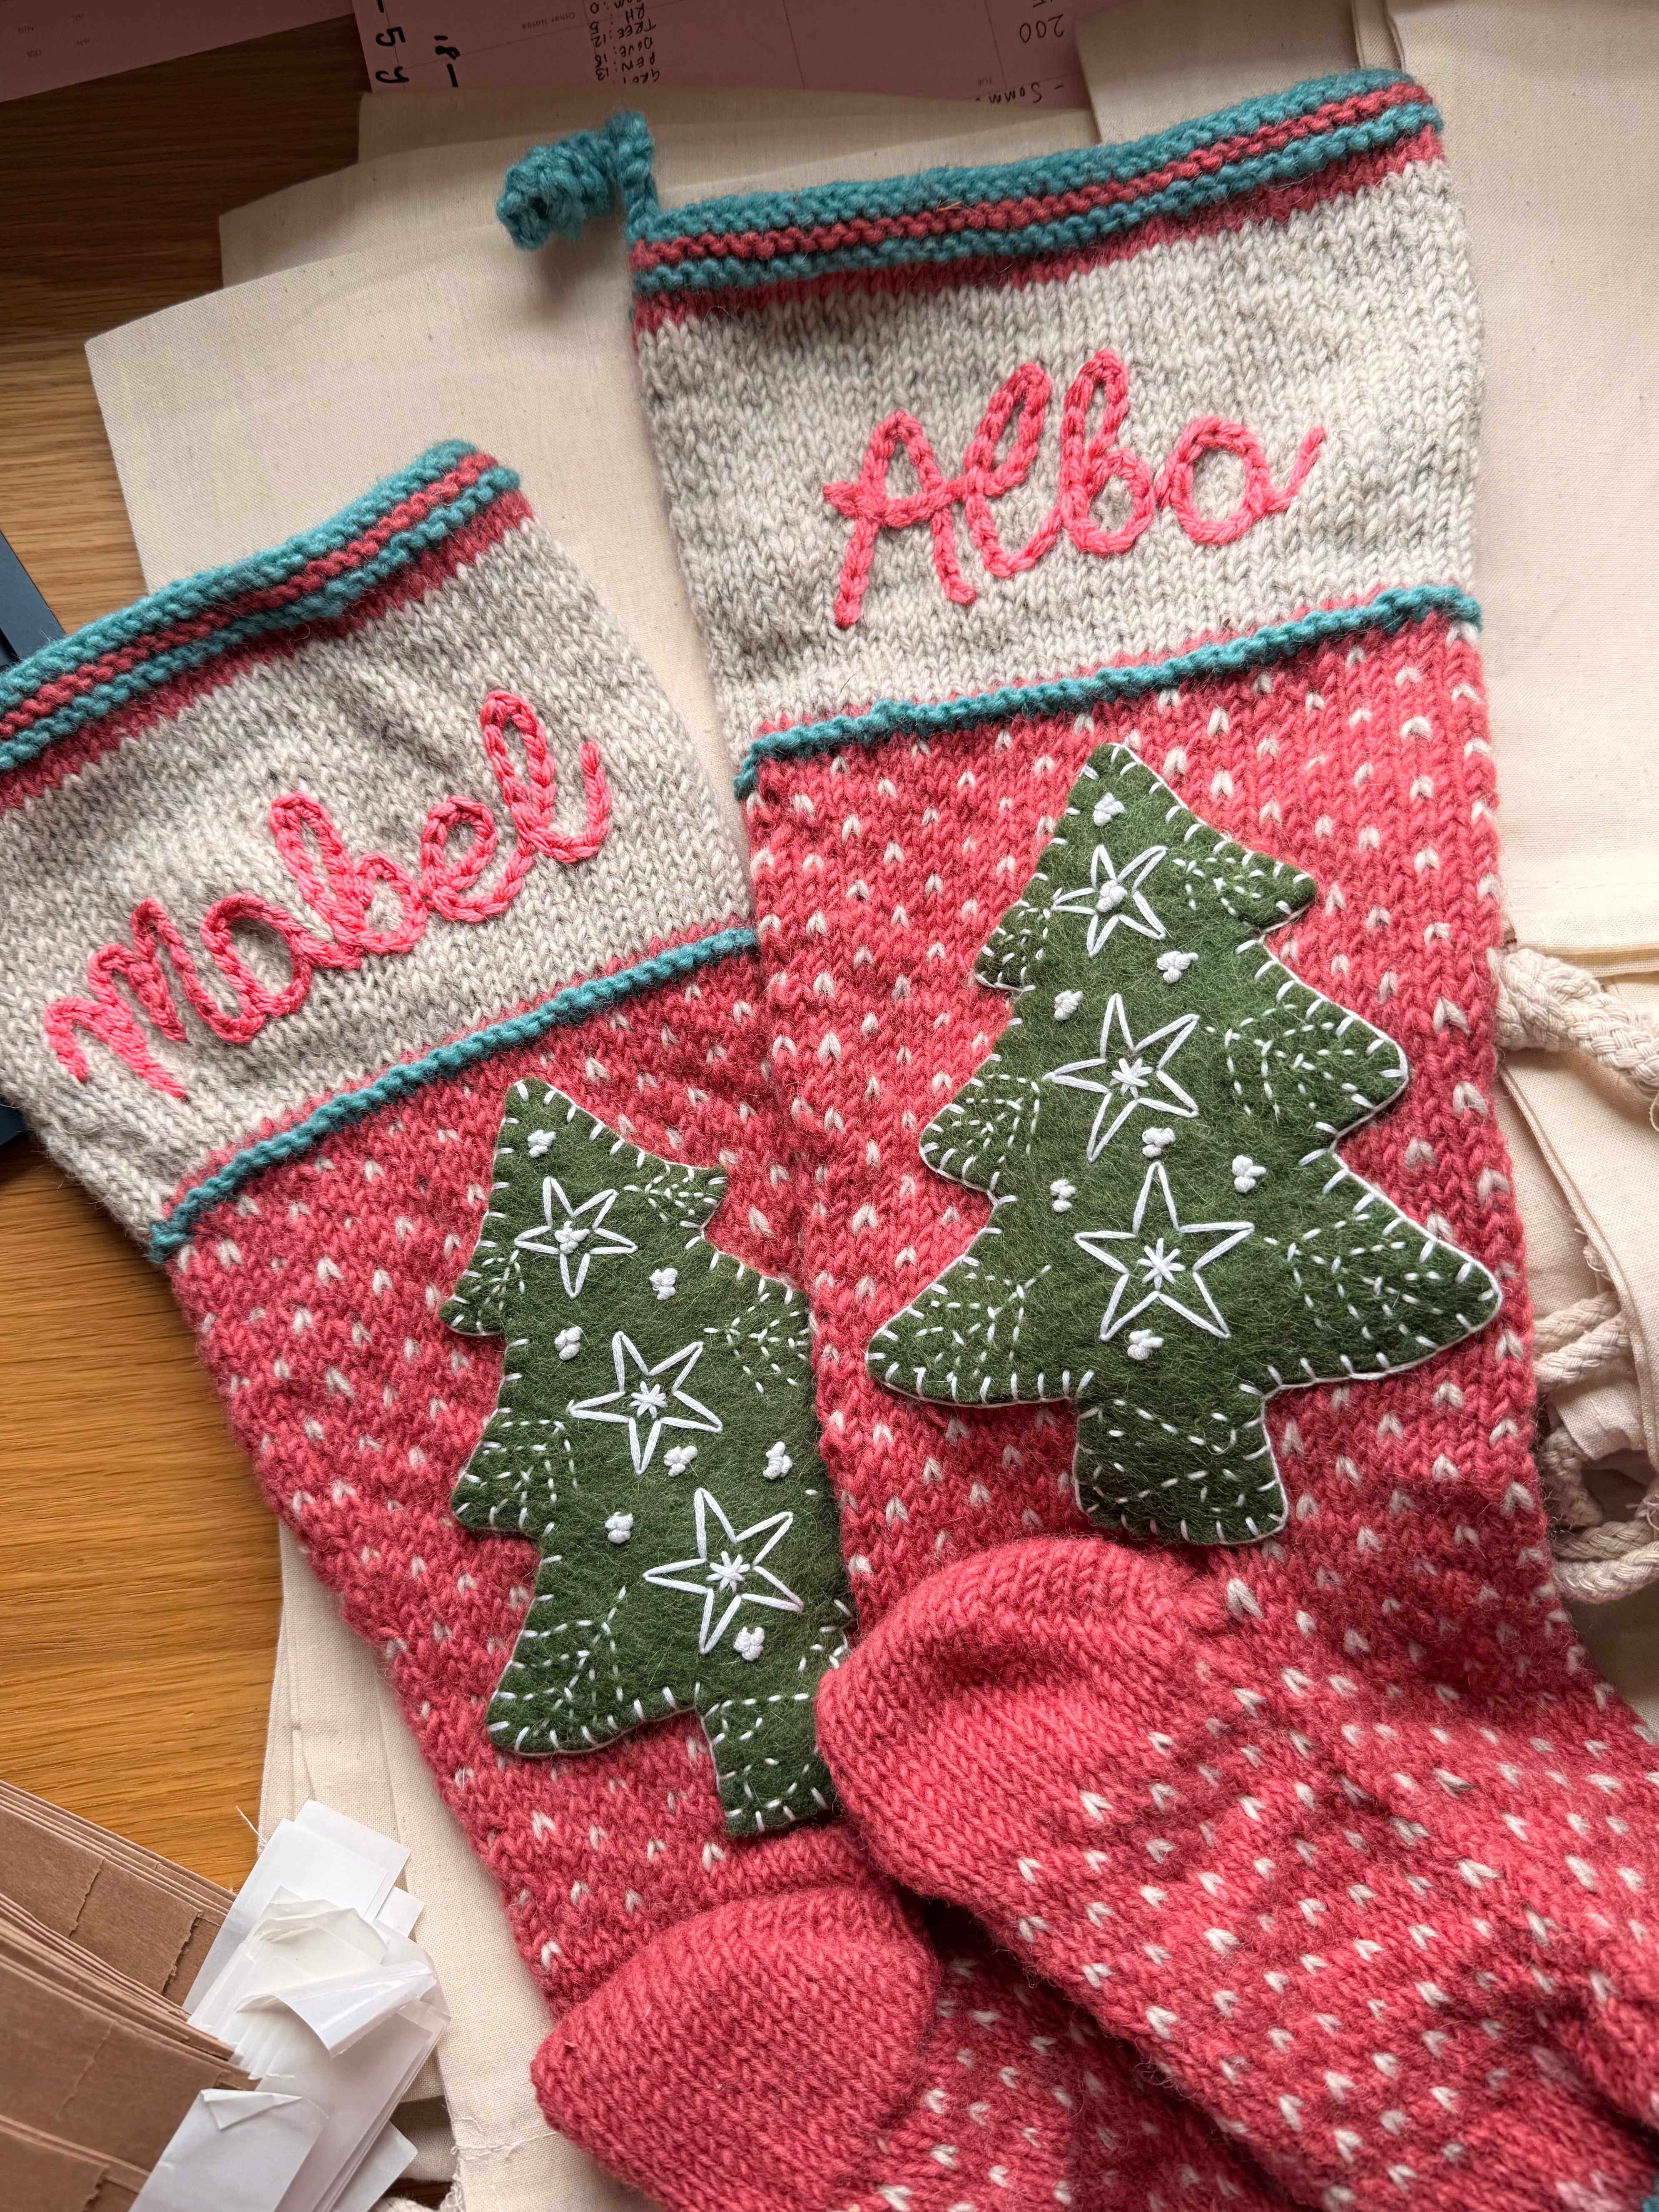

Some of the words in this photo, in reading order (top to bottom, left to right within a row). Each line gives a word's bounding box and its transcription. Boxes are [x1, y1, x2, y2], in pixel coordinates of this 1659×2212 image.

[551, 11, 576, 22] Other
[1019, 13, 1064, 44] 200
[595, 67, 609, 81] 13
[822, 348, 1327, 630] Alba
[42, 688, 612, 1103] Mabel
